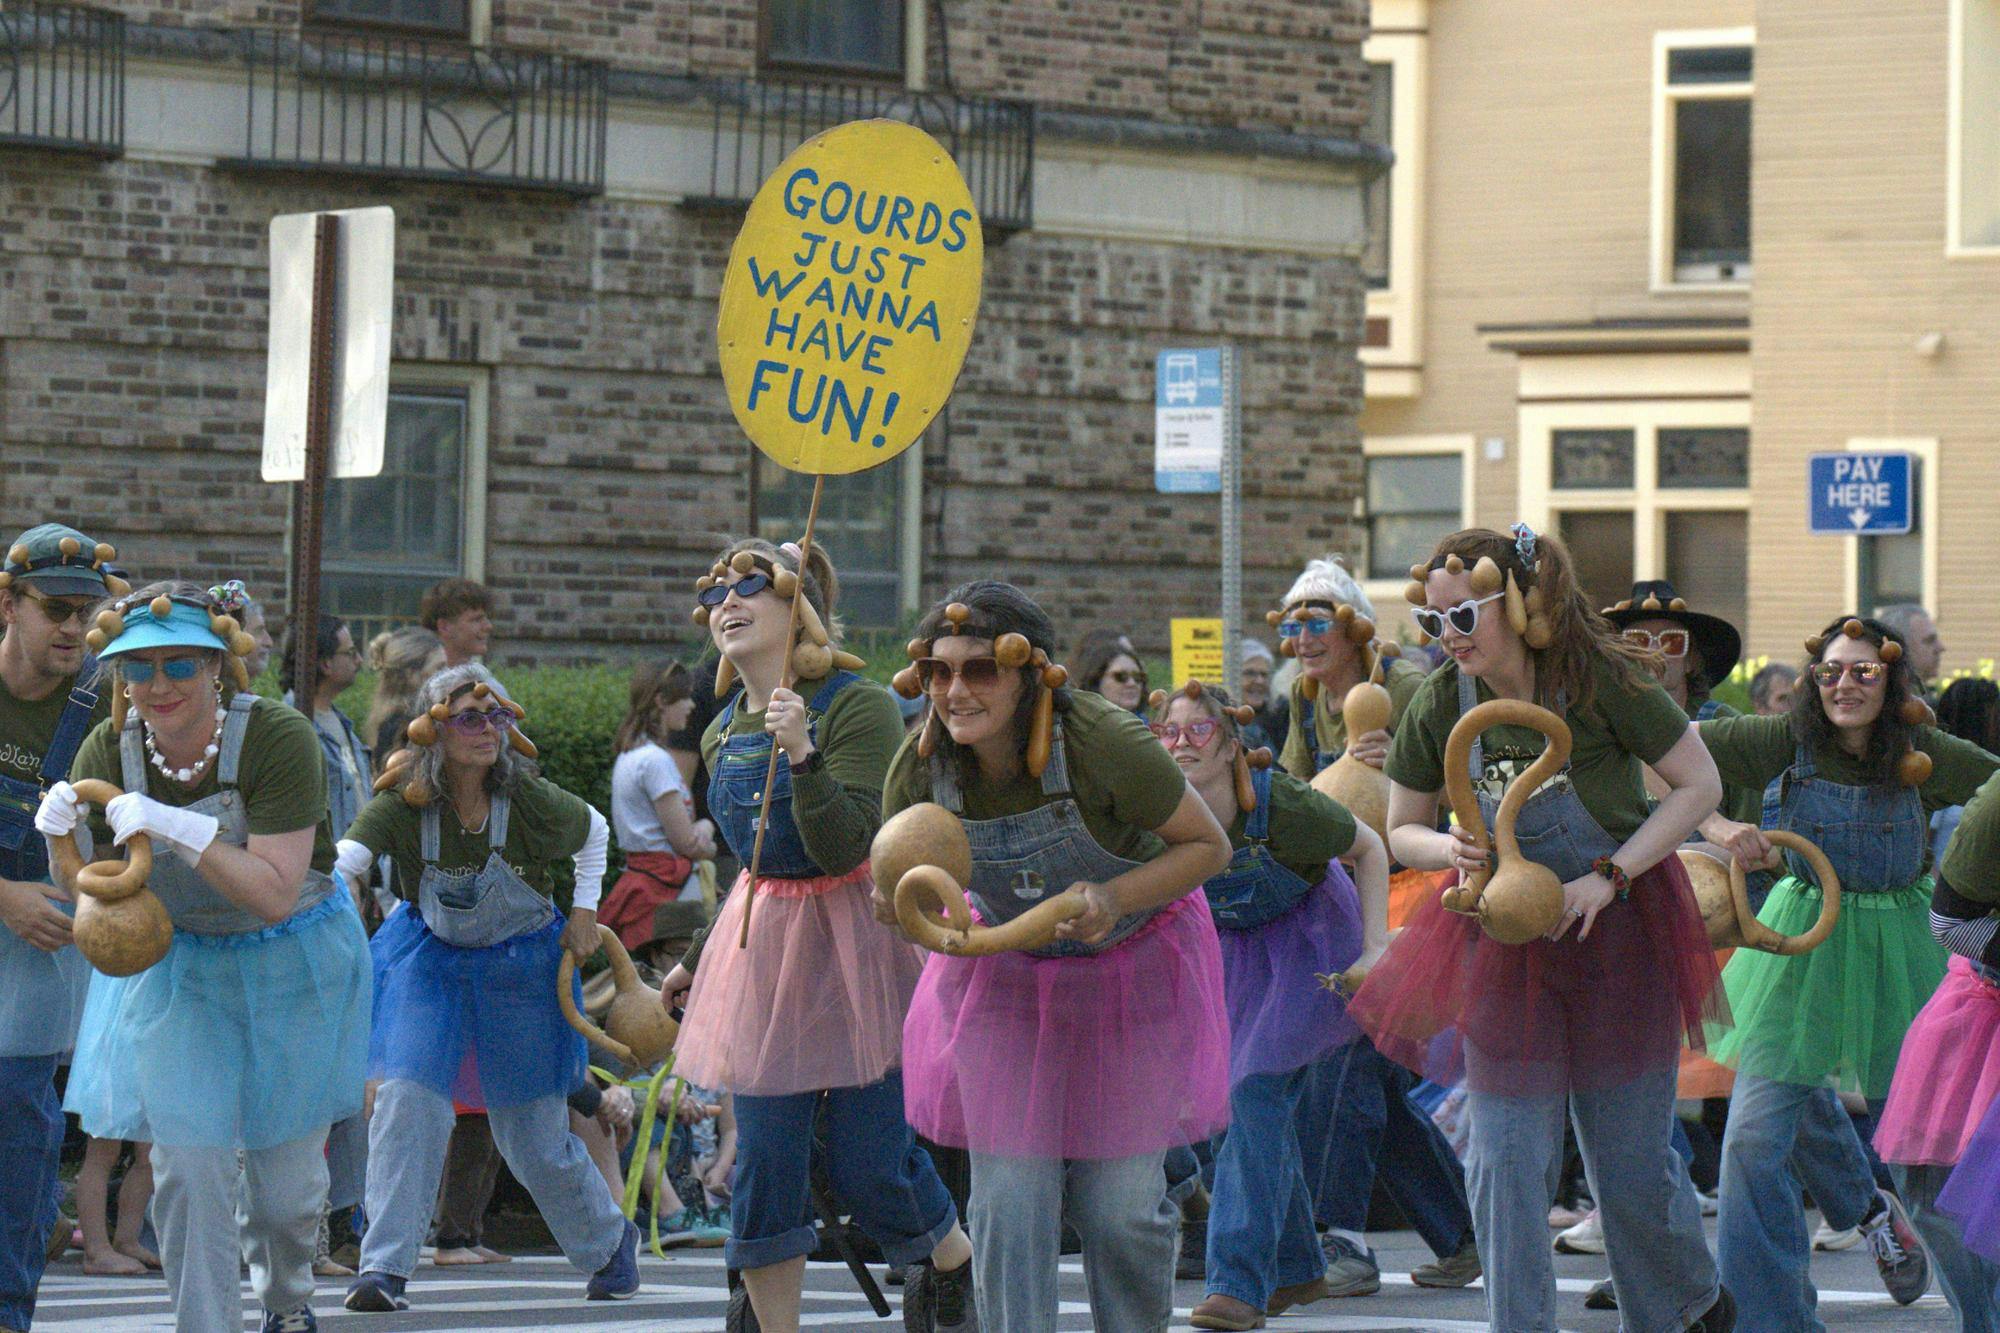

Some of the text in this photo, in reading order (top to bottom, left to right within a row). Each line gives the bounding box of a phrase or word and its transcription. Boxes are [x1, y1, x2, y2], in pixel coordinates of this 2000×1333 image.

[783, 167, 972, 252] GOURDS
[793, 232, 926, 289] JUST
[748, 256, 941, 342] WANNA
[765, 308, 893, 375] HAVE
[747, 360, 900, 448] FUN!
[1827, 482, 1891, 507] HERE
[1834, 457, 1884, 481] PAY
